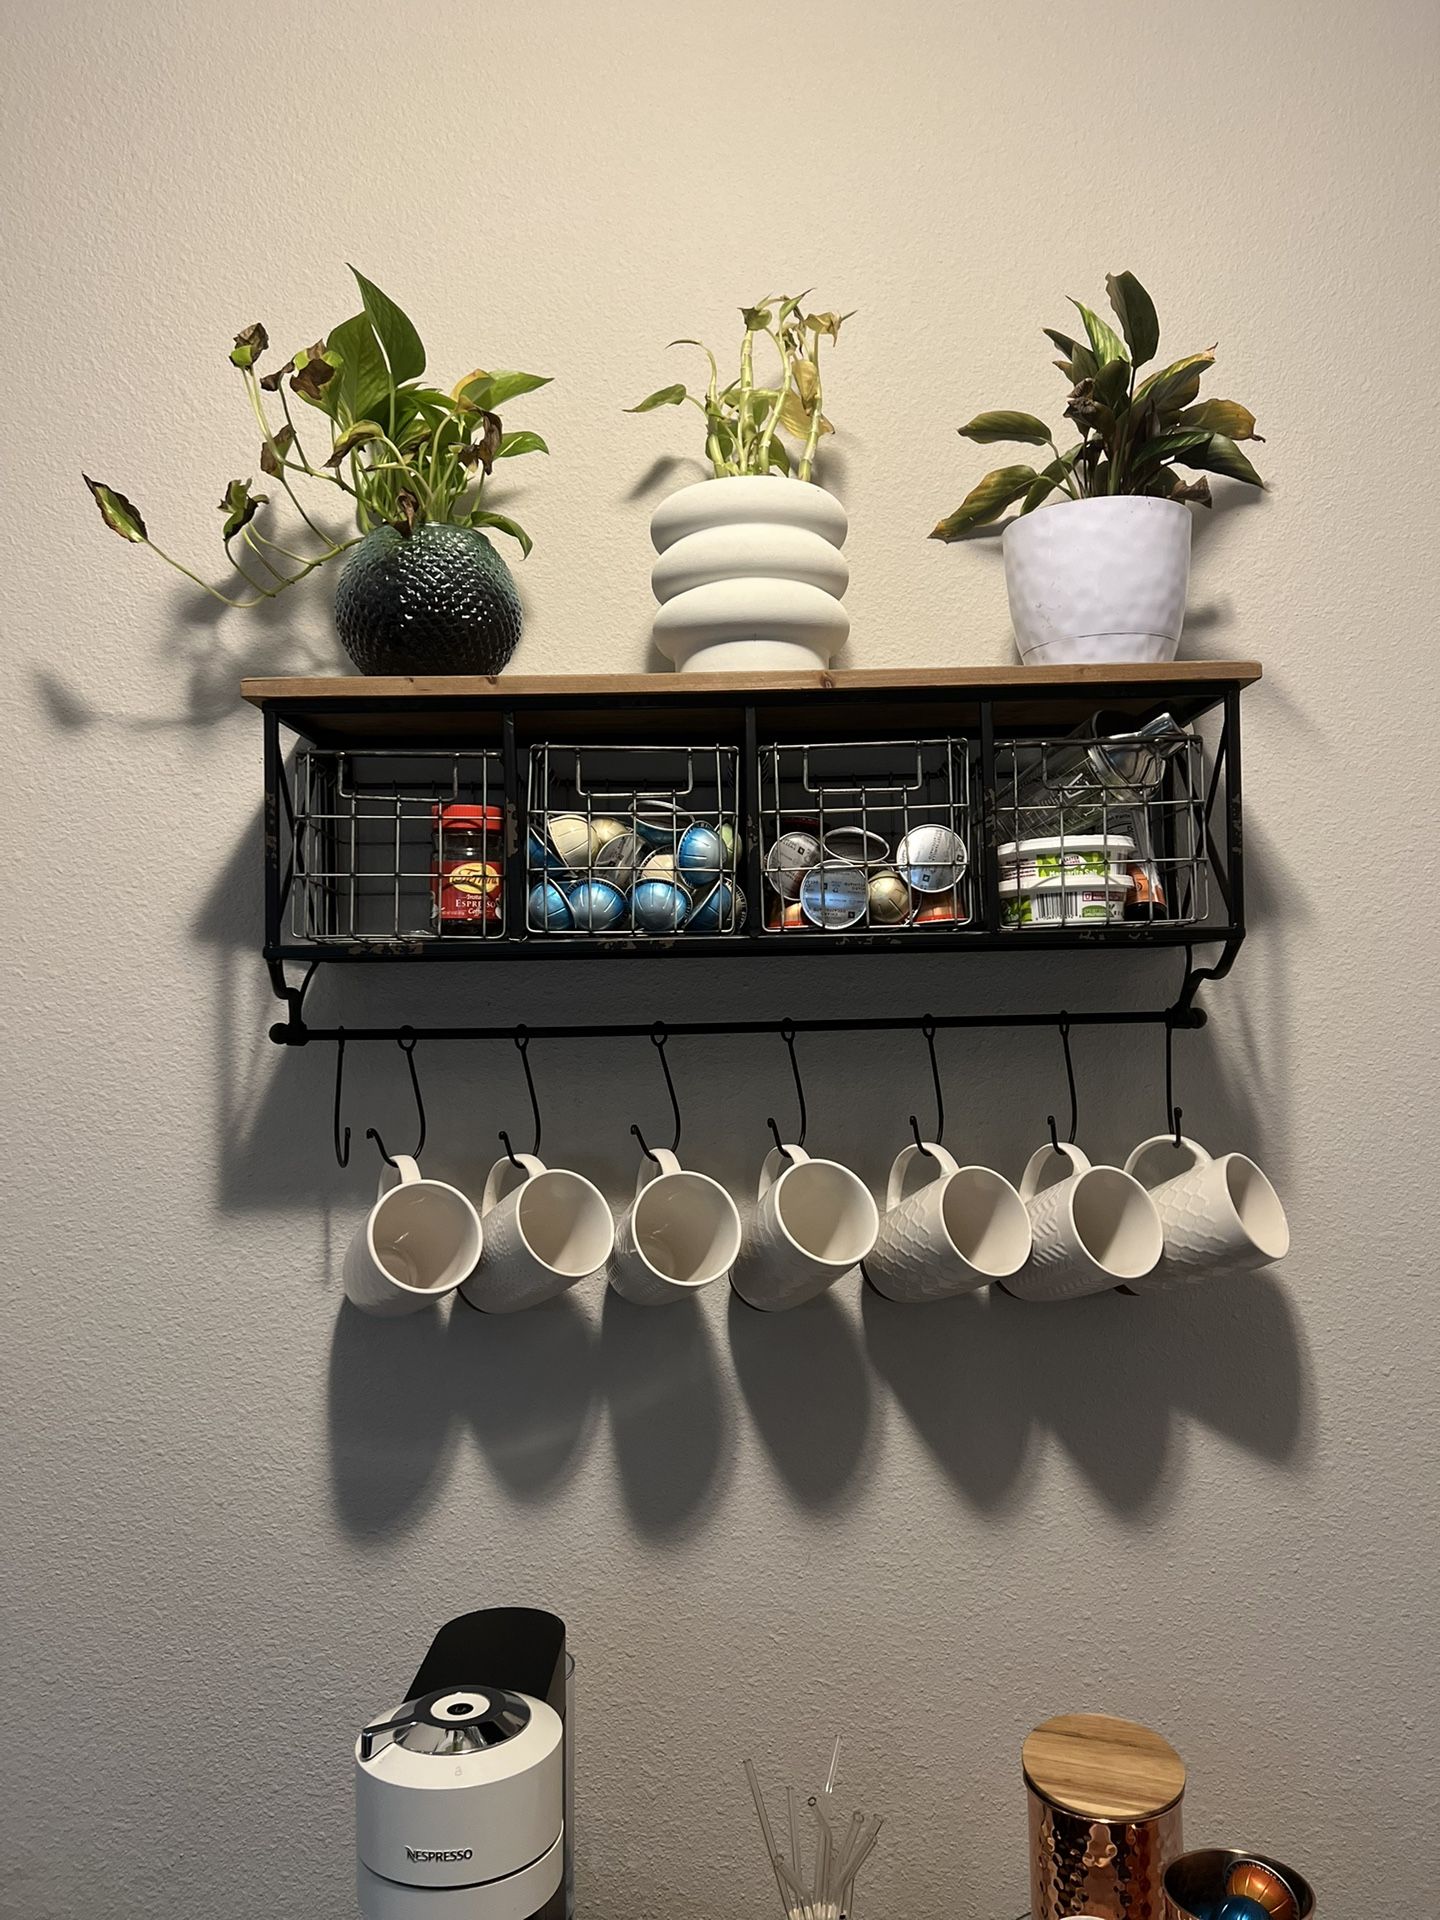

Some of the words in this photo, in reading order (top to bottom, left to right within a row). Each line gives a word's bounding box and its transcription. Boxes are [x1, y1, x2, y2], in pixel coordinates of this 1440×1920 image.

[1049, 869, 1083, 877] Mararita
[455, 898, 496, 908] ESPRESO
[467, 907, 483, 917] Coff
[404, 1845, 473, 1863] NESPRESSO
